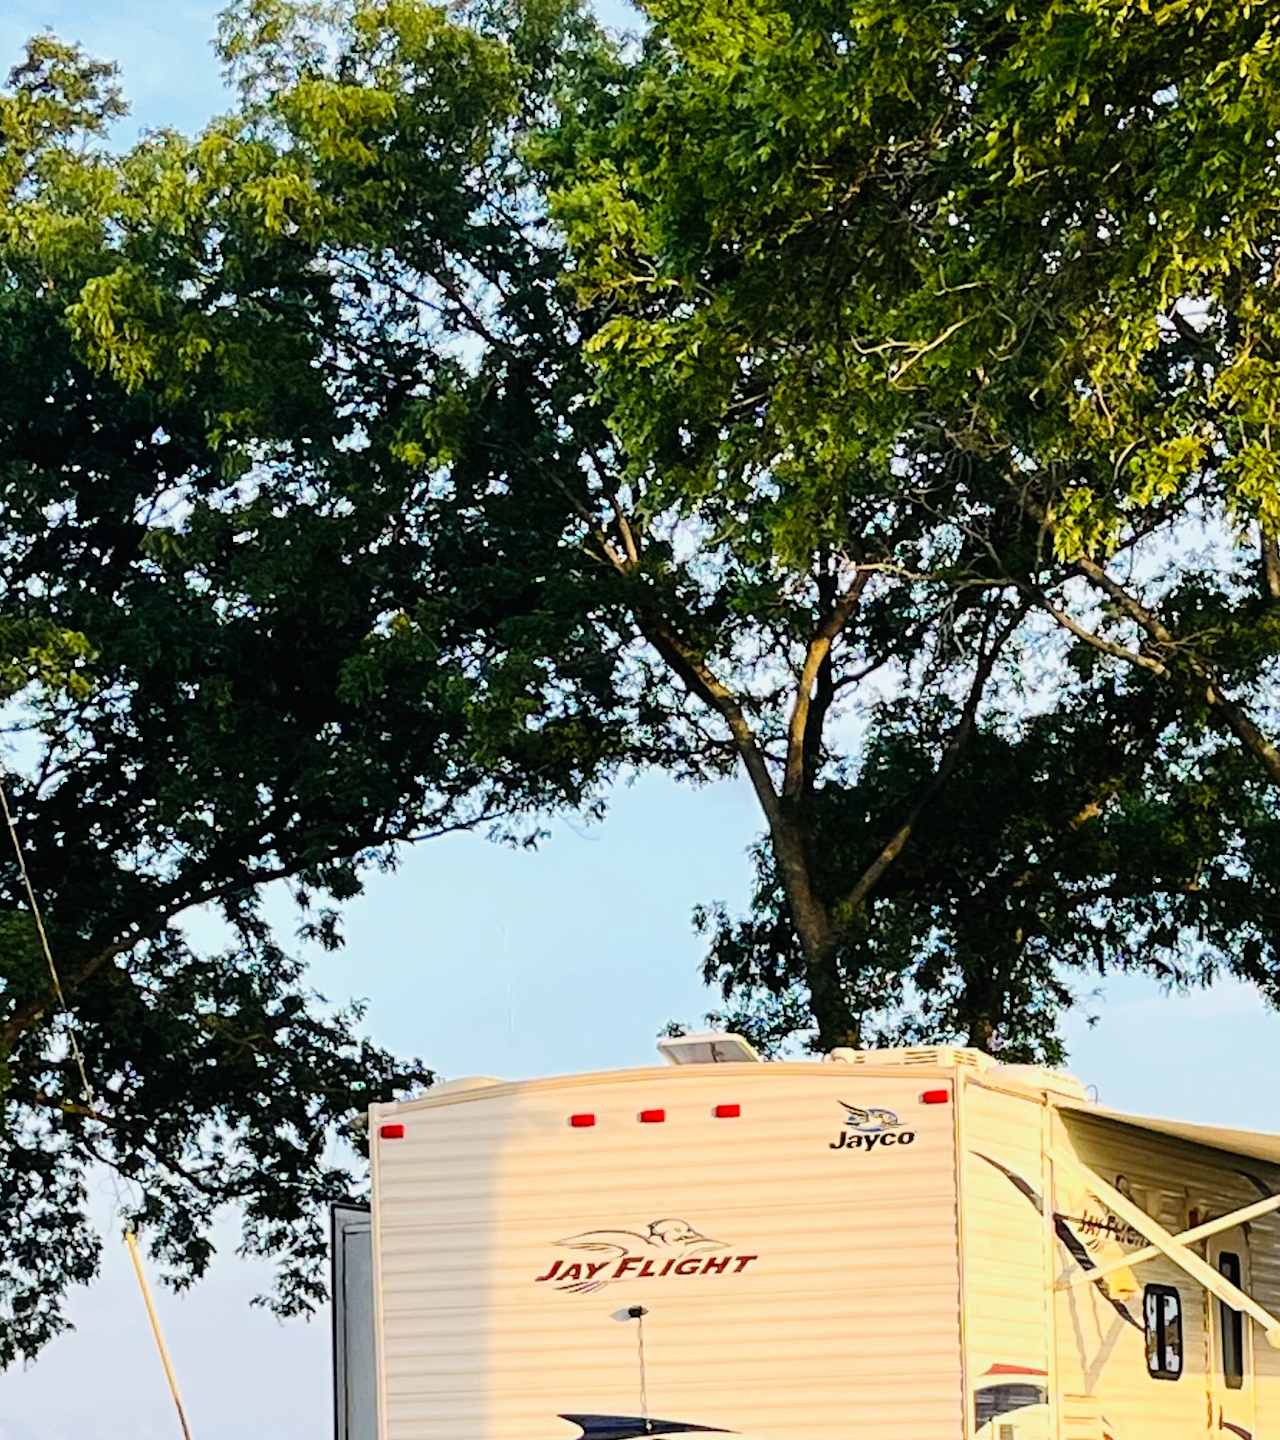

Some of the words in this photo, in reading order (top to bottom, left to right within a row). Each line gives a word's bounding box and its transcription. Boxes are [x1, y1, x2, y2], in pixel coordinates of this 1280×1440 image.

[829, 1131, 915, 1152] Jayco
[535, 1260, 610, 1281] JAY
[611, 1255, 759, 1279] FLIGHT
